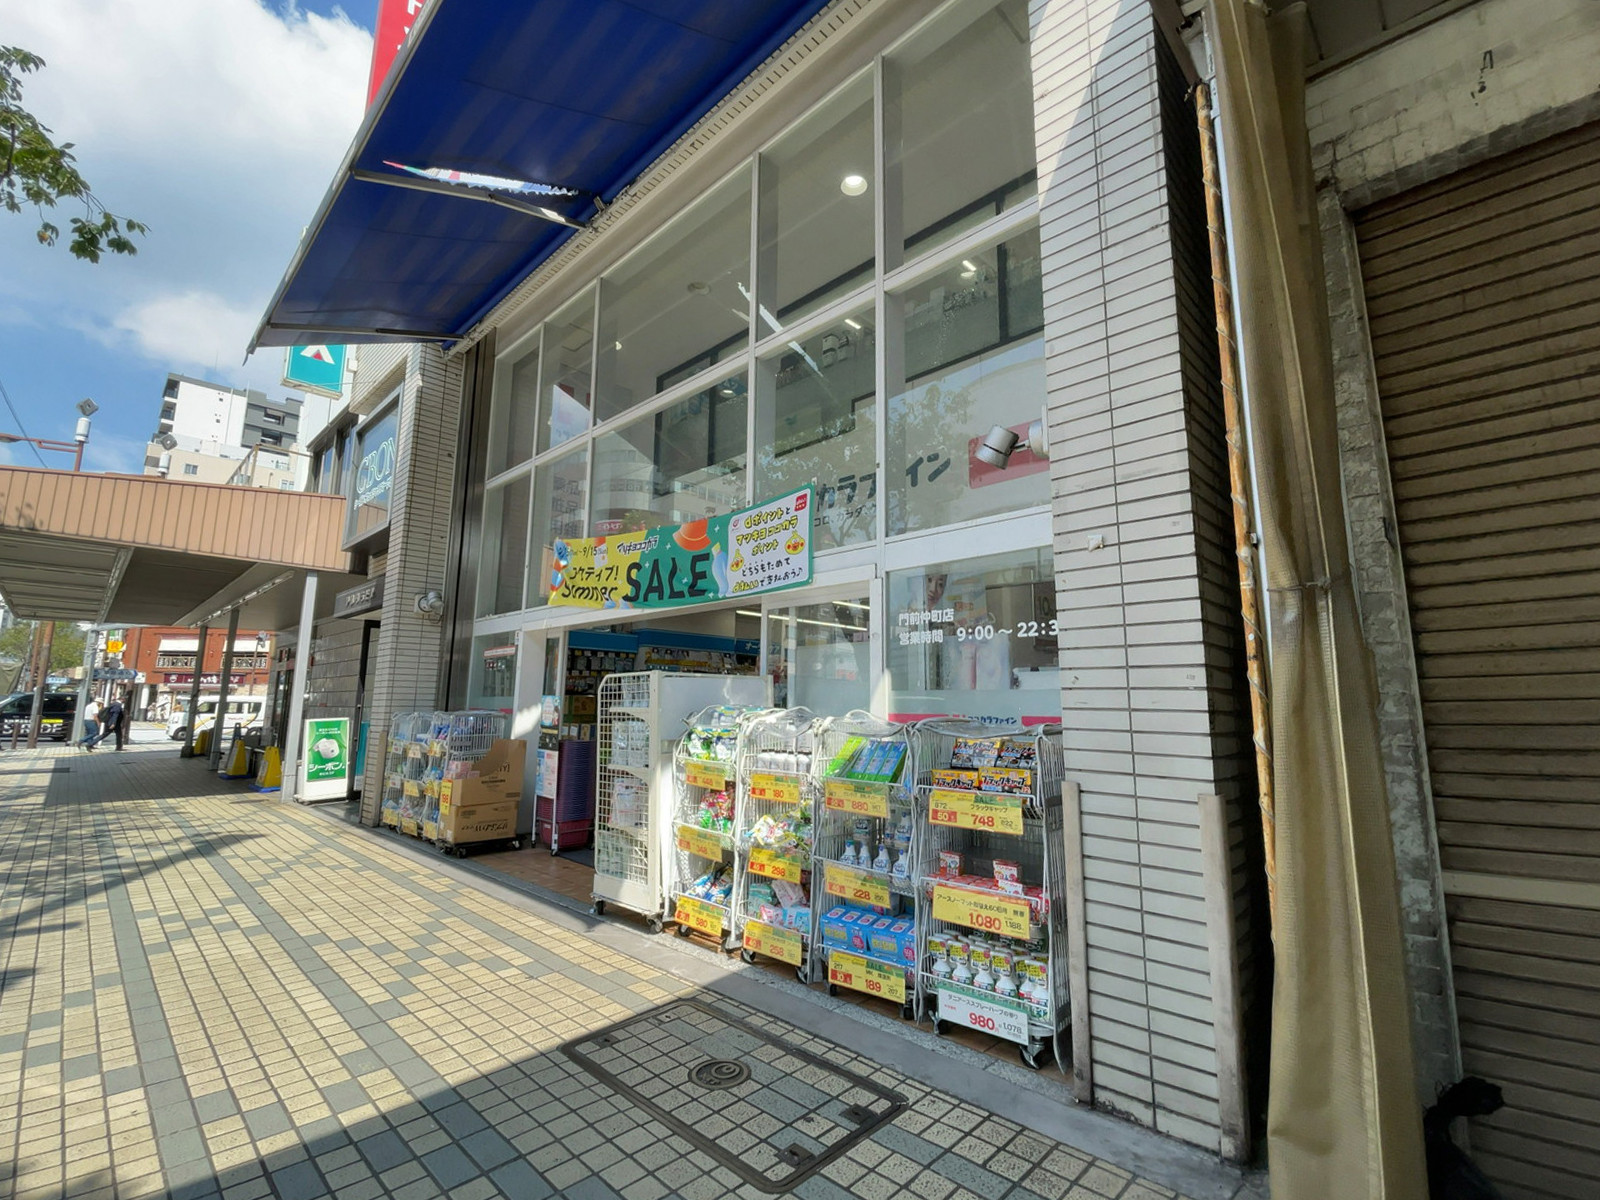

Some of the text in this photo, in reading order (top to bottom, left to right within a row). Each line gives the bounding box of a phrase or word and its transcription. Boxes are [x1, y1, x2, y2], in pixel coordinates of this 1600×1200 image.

[736, 515, 798, 546] マツキヨココカラ
[752, 539, 779, 556] ポイント
[622, 553, 711, 603] SALE
[898, 608, 955, 627] 門前仲町店
[899, 630, 944, 646] 営業時間
[851, 800, 869, 812] 880
[970, 803, 1008, 813] ブラックキャップ
[971, 813, 995, 828] 748
[853, 888, 871, 900] 228
[968, 911, 1002, 931] 1,080
[865, 979, 882, 993] 189
[969, 1012, 996, 1031] 980
